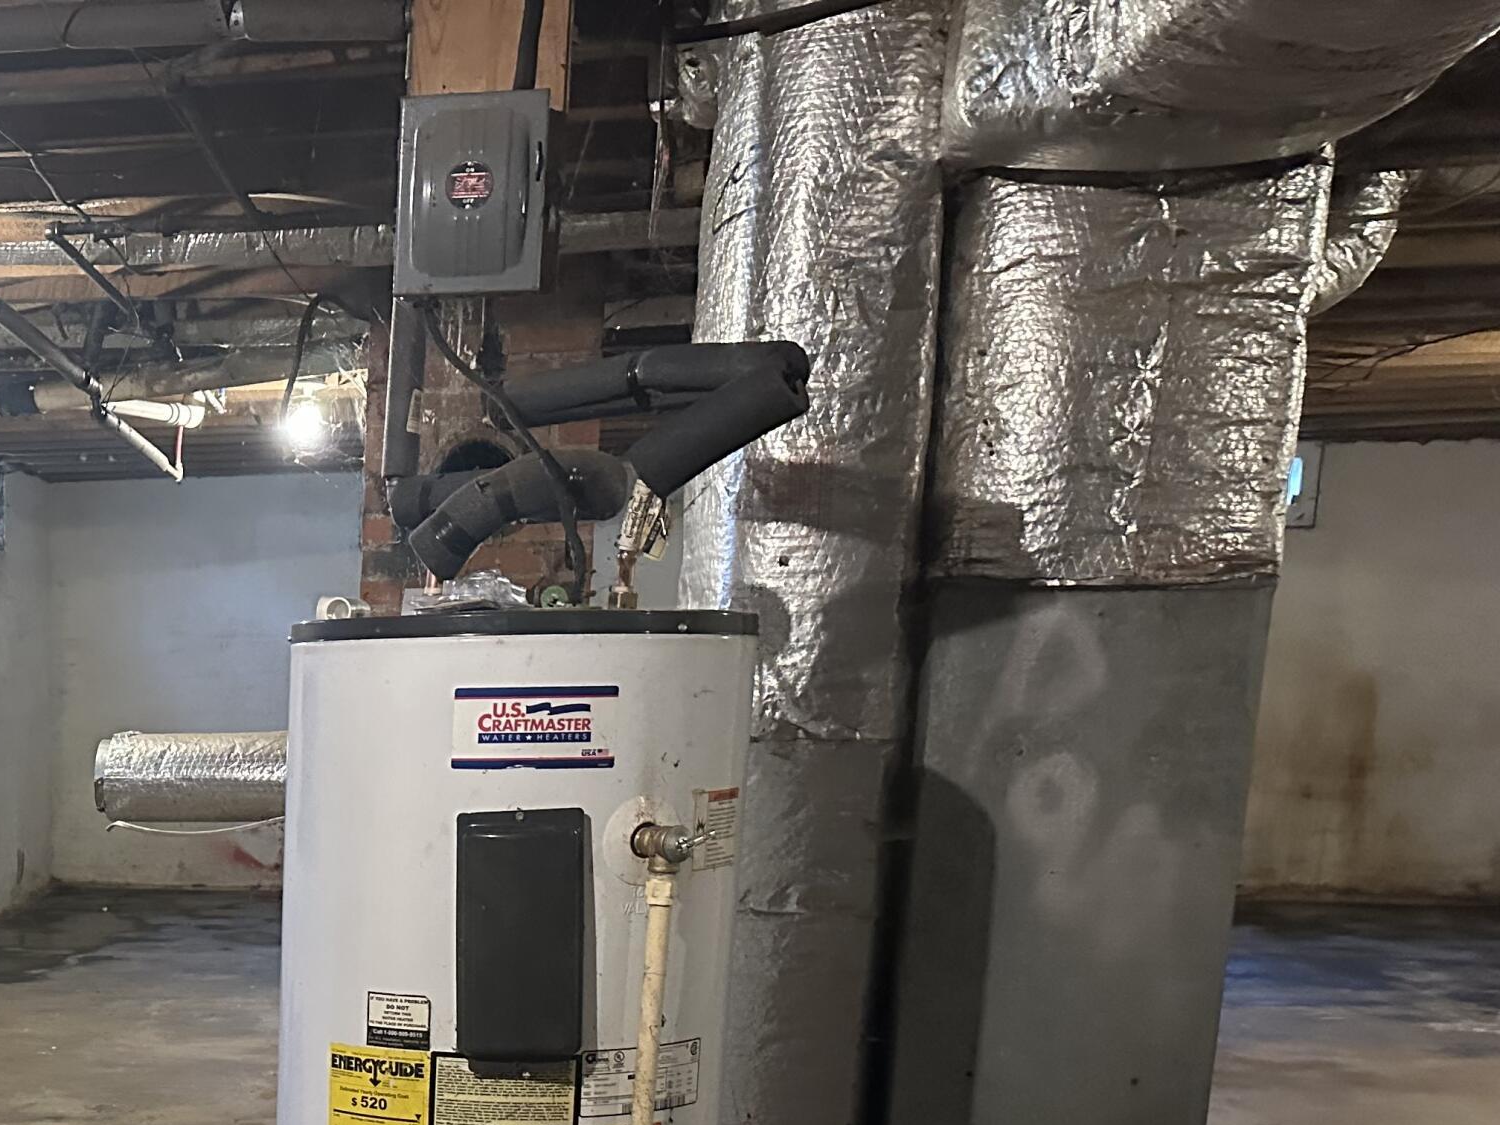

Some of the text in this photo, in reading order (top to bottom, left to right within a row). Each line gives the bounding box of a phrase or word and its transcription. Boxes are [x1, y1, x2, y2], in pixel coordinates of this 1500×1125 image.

[493, 702, 526, 718] U.S.
[477, 713, 592, 732] CRAFTMASTER
[481, 733, 588, 742] WATER HEATERS
[331, 1053, 425, 1080] ENERGYGUIDE
[351, 1095, 388, 1111] $ 520
